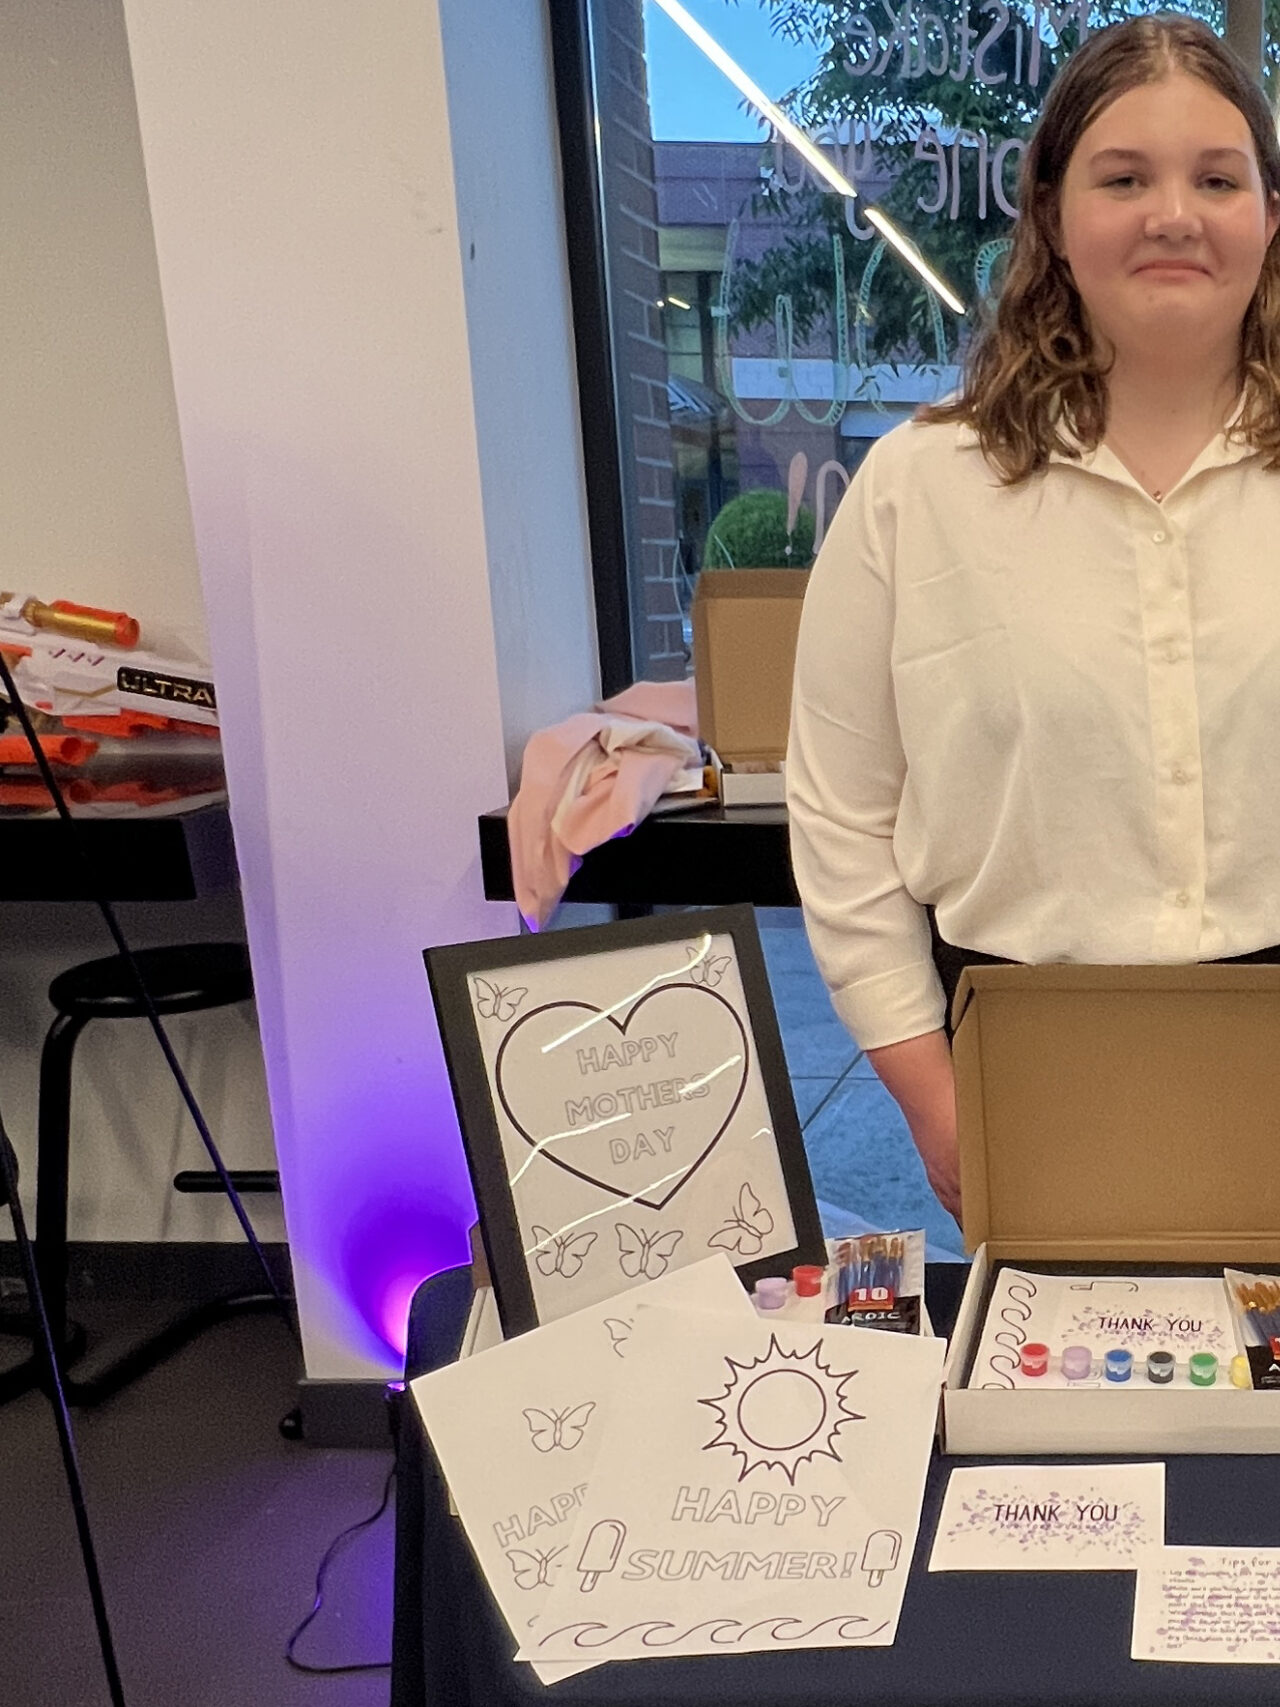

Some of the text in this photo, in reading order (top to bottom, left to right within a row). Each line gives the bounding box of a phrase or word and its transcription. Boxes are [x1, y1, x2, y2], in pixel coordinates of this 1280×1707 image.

[120, 672, 214, 704] ULTRA
[577, 1032, 679, 1075] HAPPY
[608, 1126, 675, 1165] DAY
[854, 1287, 888, 1300] 10
[1099, 1316, 1202, 1332] THANK YOU
[671, 1487, 847, 1527] HAPPY
[993, 1504, 1118, 1521] THANK YOU
[621, 1550, 857, 1582] SUMMER!
